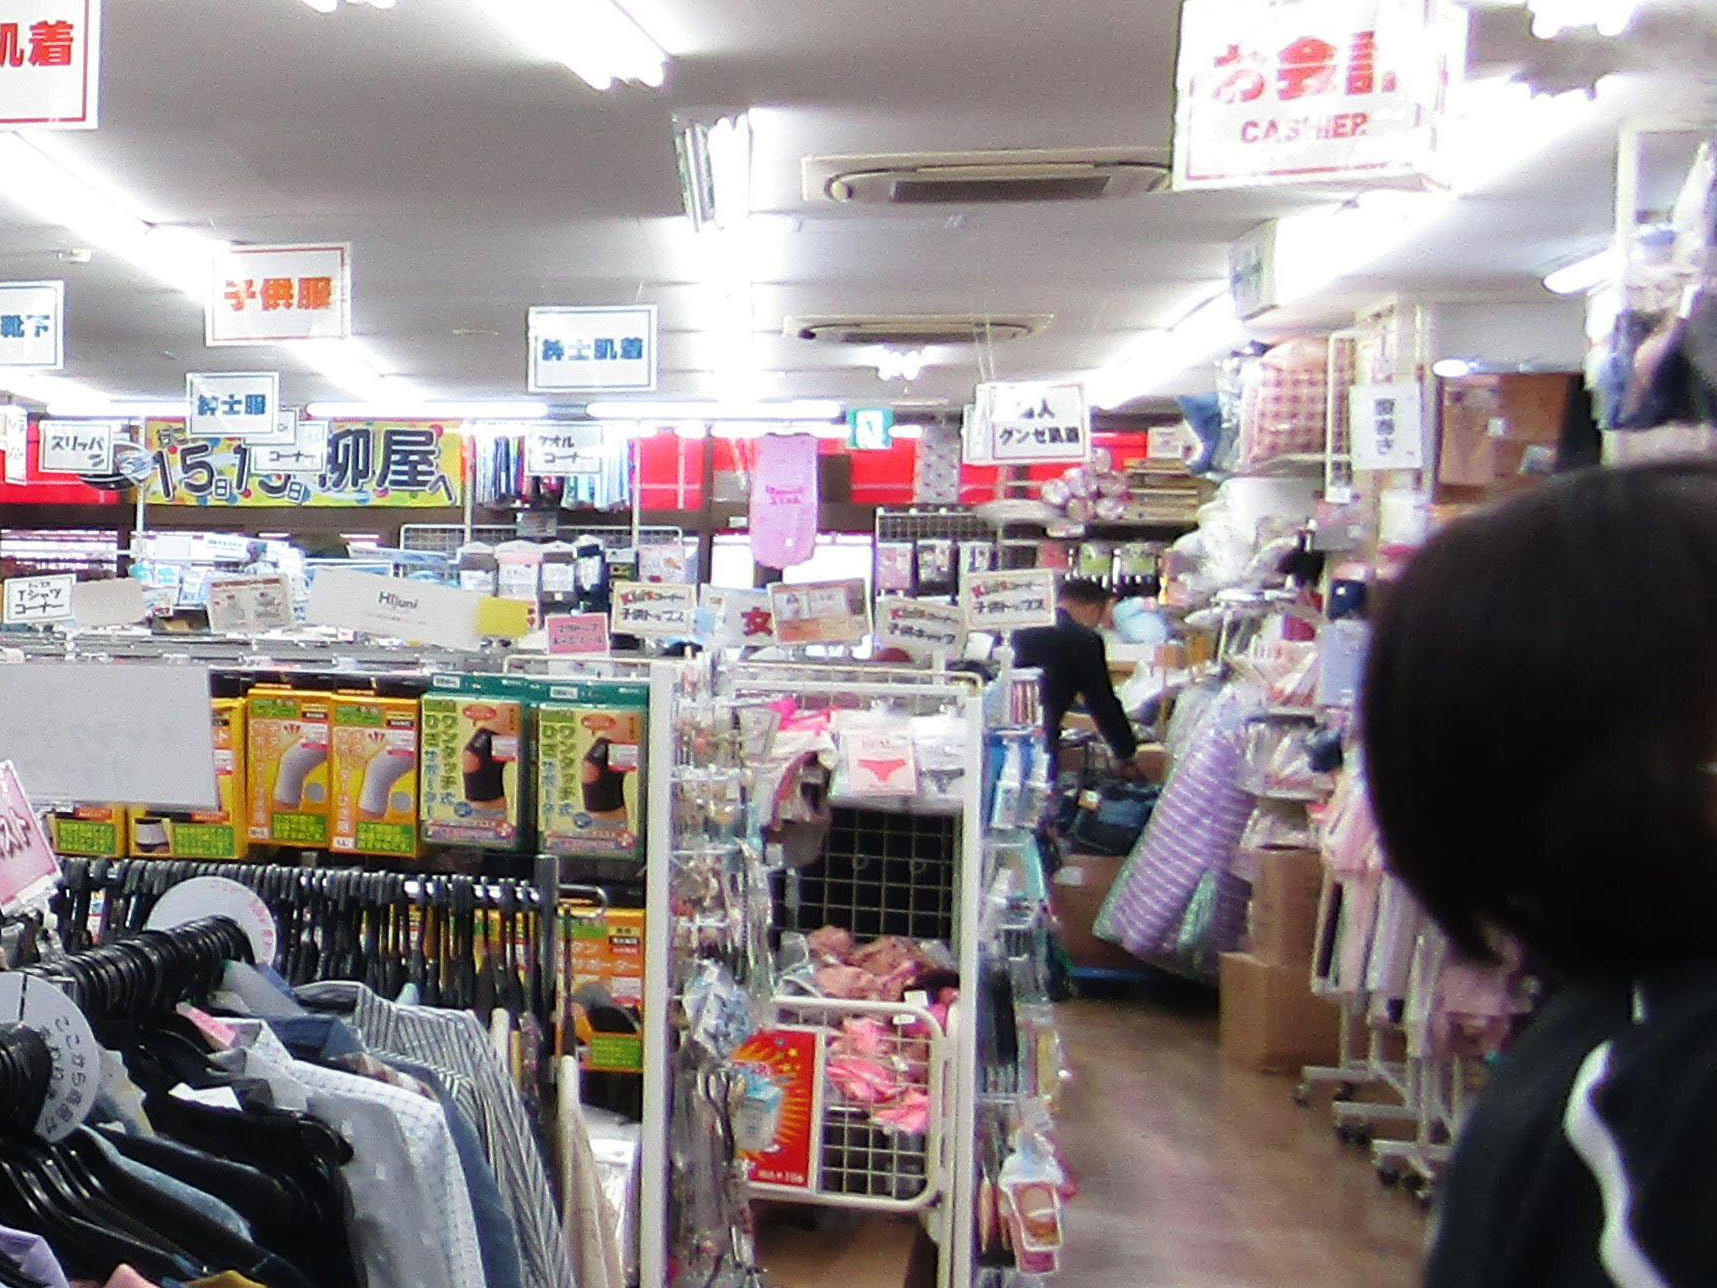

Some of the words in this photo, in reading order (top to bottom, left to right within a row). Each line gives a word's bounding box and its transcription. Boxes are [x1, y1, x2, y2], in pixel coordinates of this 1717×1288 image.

[223, 275, 333, 312] 子供服
[740, 605, 774, 637] 女
